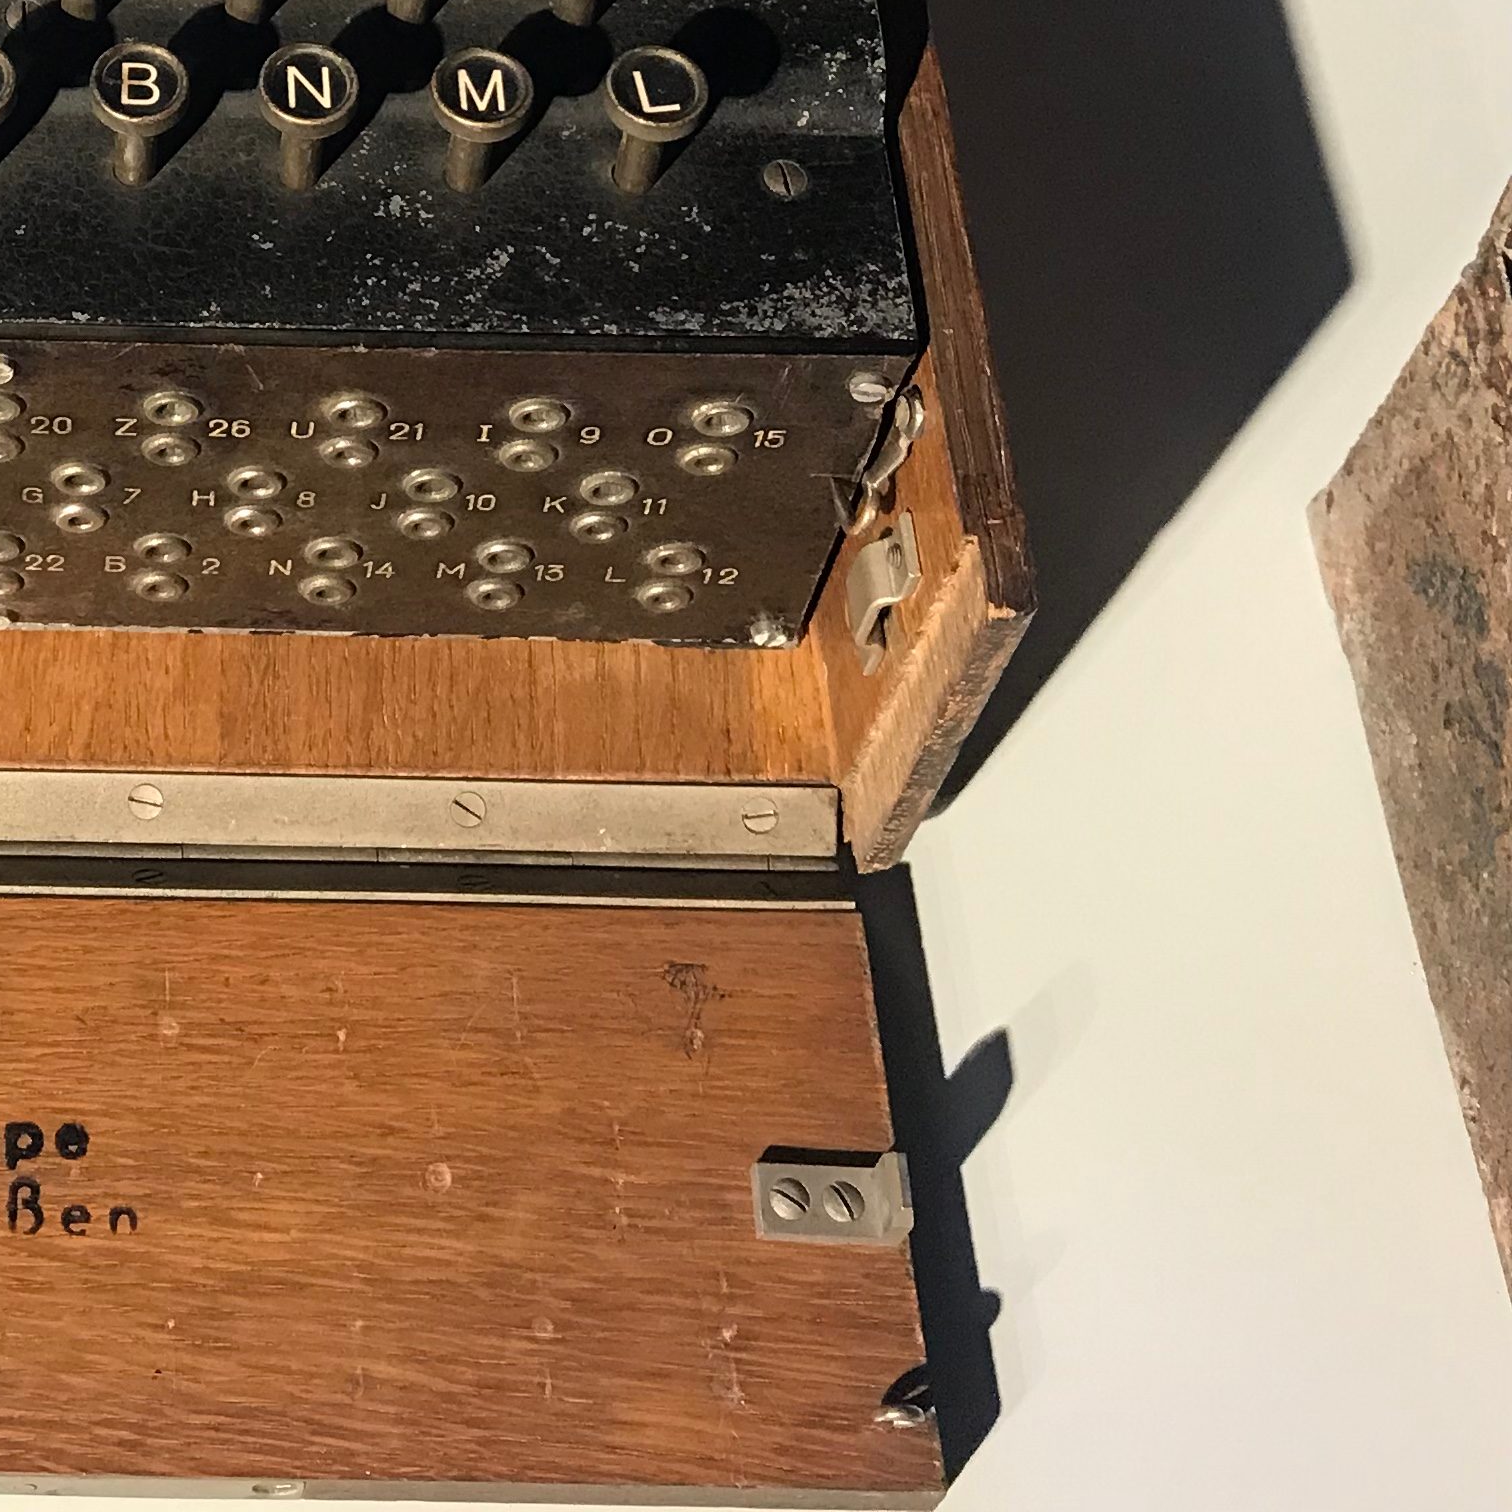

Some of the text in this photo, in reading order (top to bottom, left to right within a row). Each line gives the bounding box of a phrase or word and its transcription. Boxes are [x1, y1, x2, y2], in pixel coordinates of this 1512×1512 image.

[120, 62, 161, 106] B
[286, 65, 332, 109] N
[457, 68, 506, 112] M
[632, 70, 681, 114] L
[30, 415, 72, 435] 20
[114, 417, 138, 437] Z
[208, 418, 251, 438] 26
[290, 421, 315, 440] U
[388, 422, 424, 441] 21
[476, 424, 493, 443] I
[579, 426, 601, 445] 9
[753, 429, 787, 449] 15
[21, 487, 44, 504] G
[122, 487, 142, 505] 7
[191, 489, 215, 507] H
[296, 491, 316, 508] 8
[370, 493, 387, 510] J
[465, 494, 497, 511] 10
[542, 496, 568, 514] K
[642, 498, 667, 516] 11
[24, 553, 65, 572] 22
[104, 555, 127, 573] B
[201, 557, 221, 575] 2
[268, 559, 292, 576] N
[362, 560, 396, 579] 14
[436, 562, 466, 580] M
[534, 564, 565, 582] 13
[604, 566, 627, 583] L
[702, 567, 739, 585] 12
